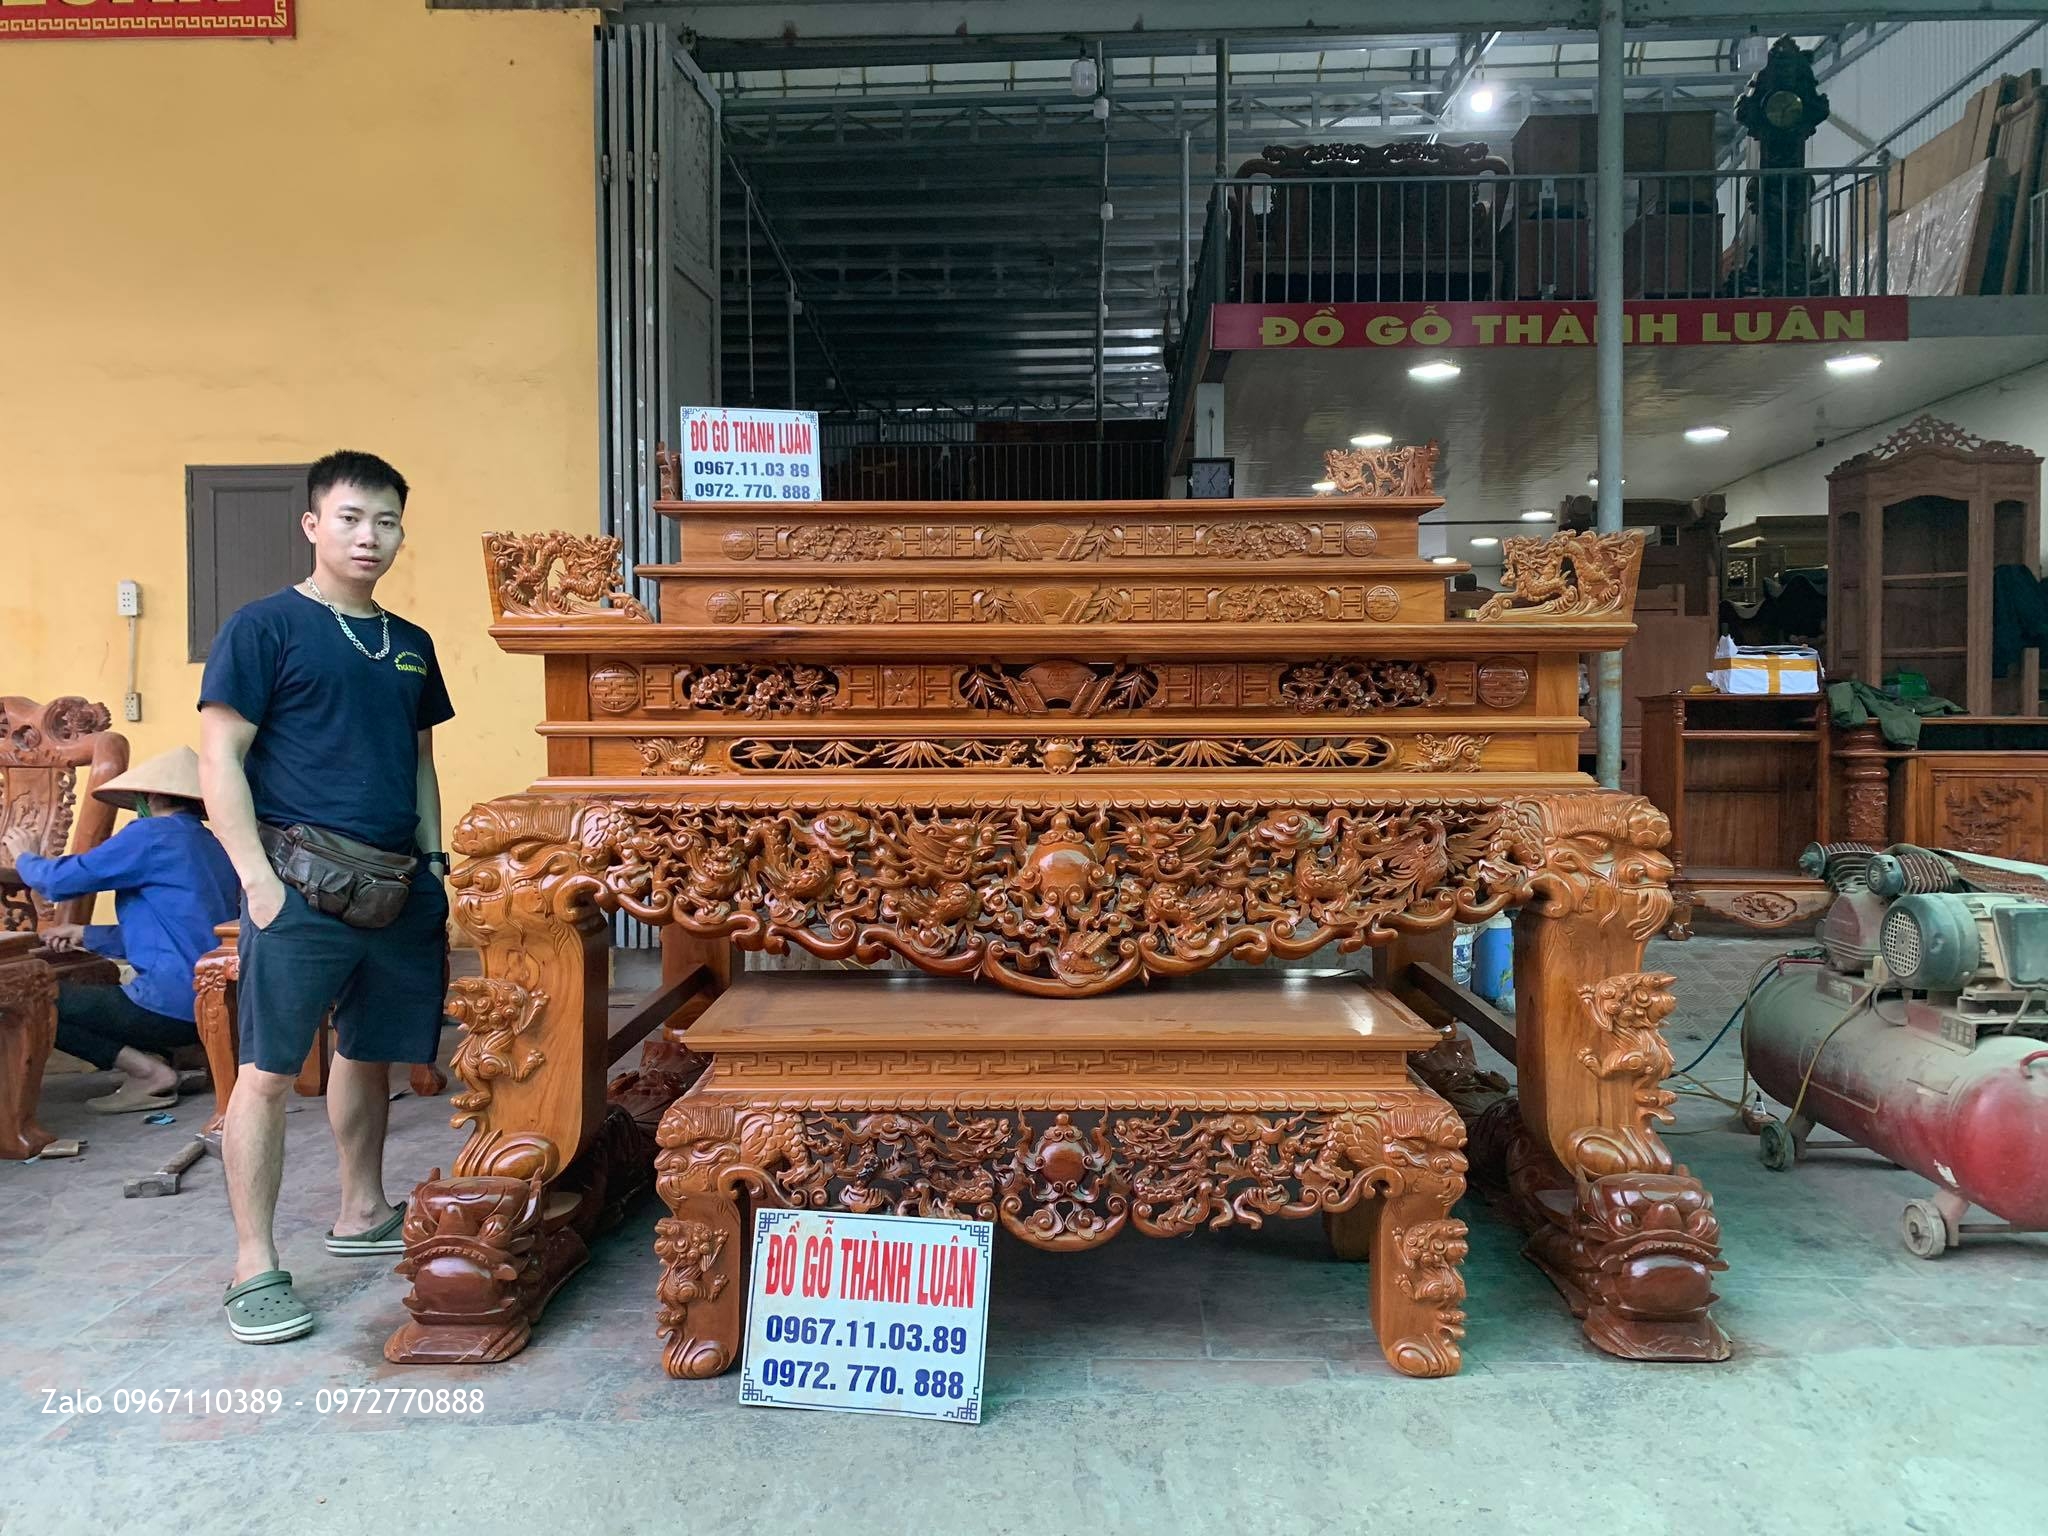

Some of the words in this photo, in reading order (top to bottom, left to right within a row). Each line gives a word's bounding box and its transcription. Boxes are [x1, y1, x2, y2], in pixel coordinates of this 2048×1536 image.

[1259, 306, 1345, 346] ĐỒ
[1365, 305, 1453, 345] GỖ
[1702, 305, 1866, 342] LUÂN
[690, 411, 708, 452] ĐỒ
[711, 410, 730, 452] GỖ
[732, 415, 775, 454] THÀNH
[778, 417, 812, 455] LUÂN
[694, 483, 739, 498] 0972.
[743, 484, 777, 498] 770.
[782, 485, 811, 500] 888
[765, 1221, 800, 1296] ĐỒ
[802, 1219, 834, 1299] GỖ
[839, 1230, 913, 1304] THÀNH
[917, 1235, 978, 1308] LUÂN
[766, 1315, 967, 1355] 0967.11.03.89
[762, 1358, 836, 1391] 0972.
[847, 1364, 904, 1395] 770.
[914, 1368, 964, 1400] 888
